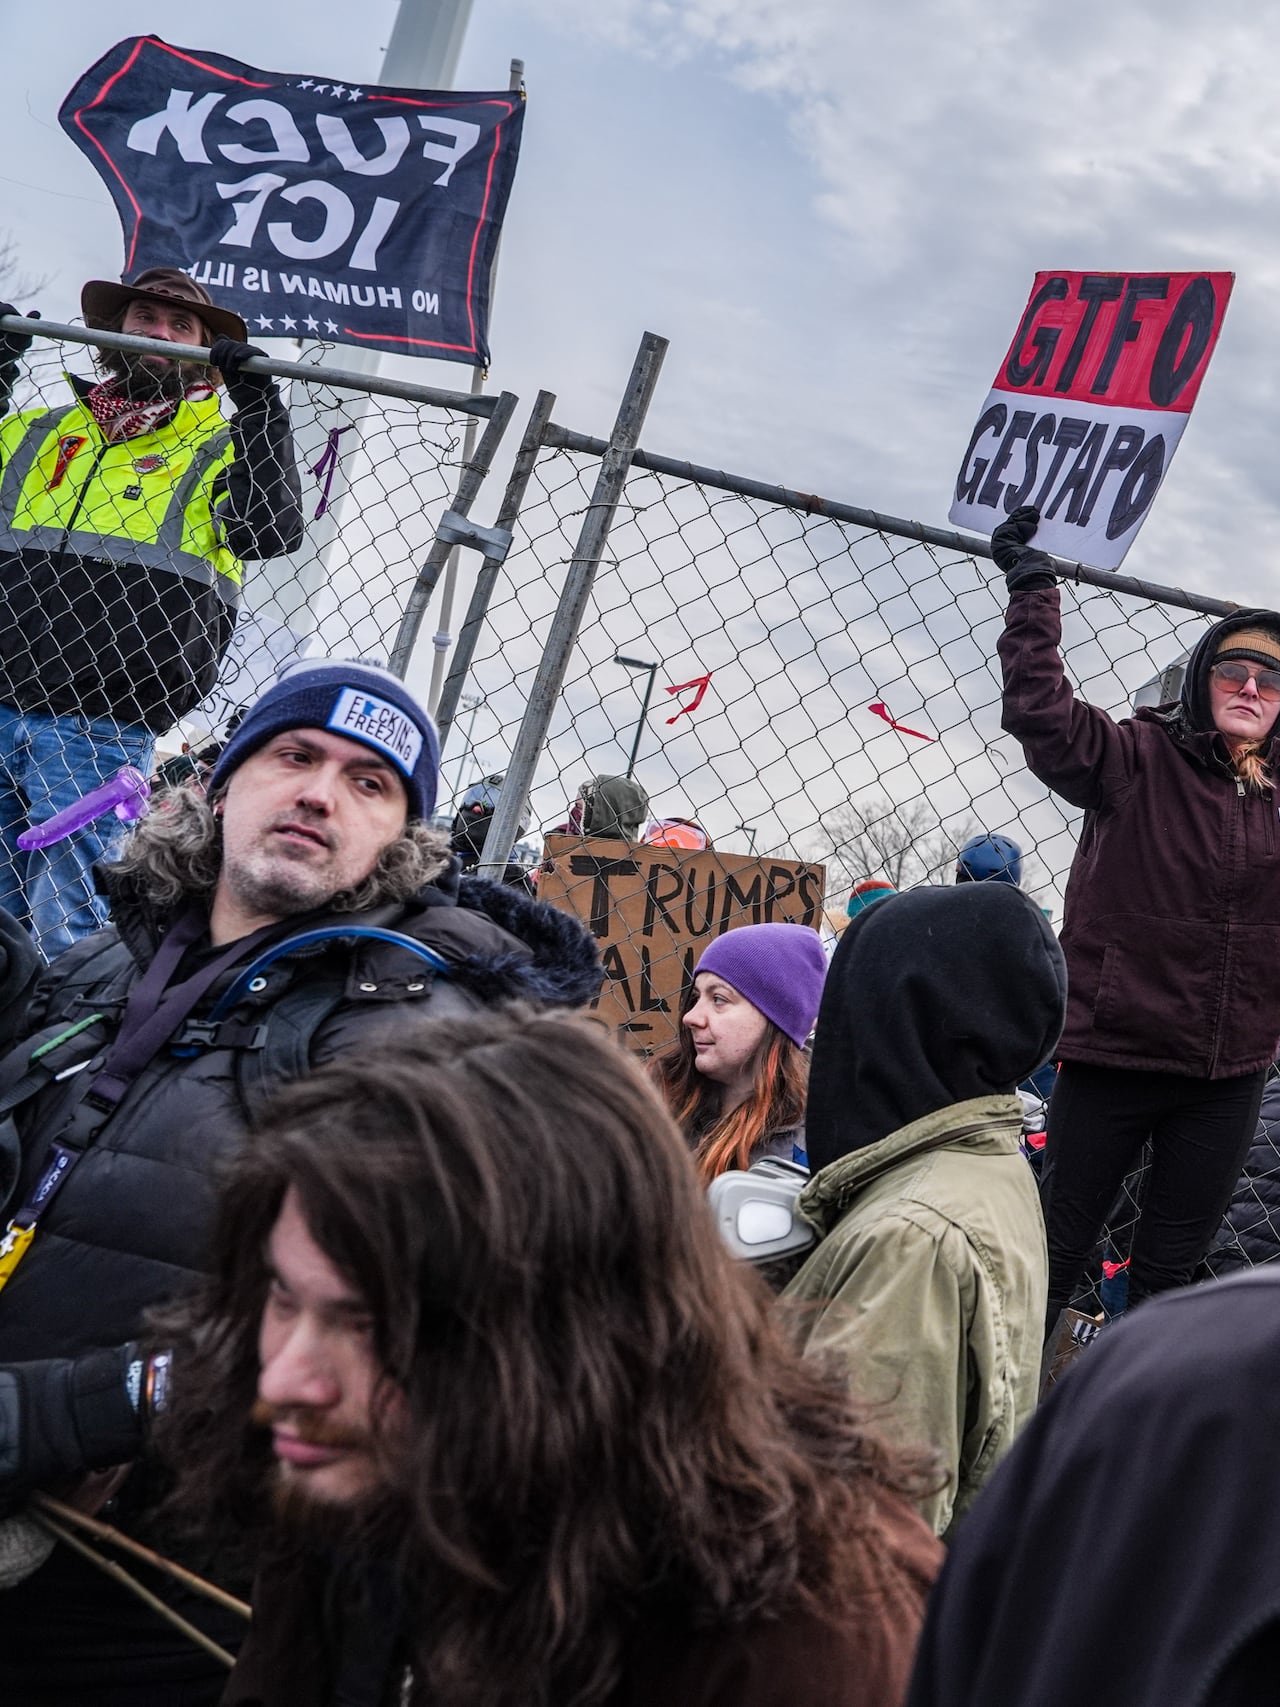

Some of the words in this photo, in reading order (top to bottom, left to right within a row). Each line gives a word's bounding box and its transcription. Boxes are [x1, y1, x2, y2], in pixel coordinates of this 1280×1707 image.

[1005, 276, 1217, 408] GTFO
[956, 402, 1166, 541] GESTAPO
[344, 711, 412, 761] FREEZING
[569, 855, 820, 938] TRUMP'S
